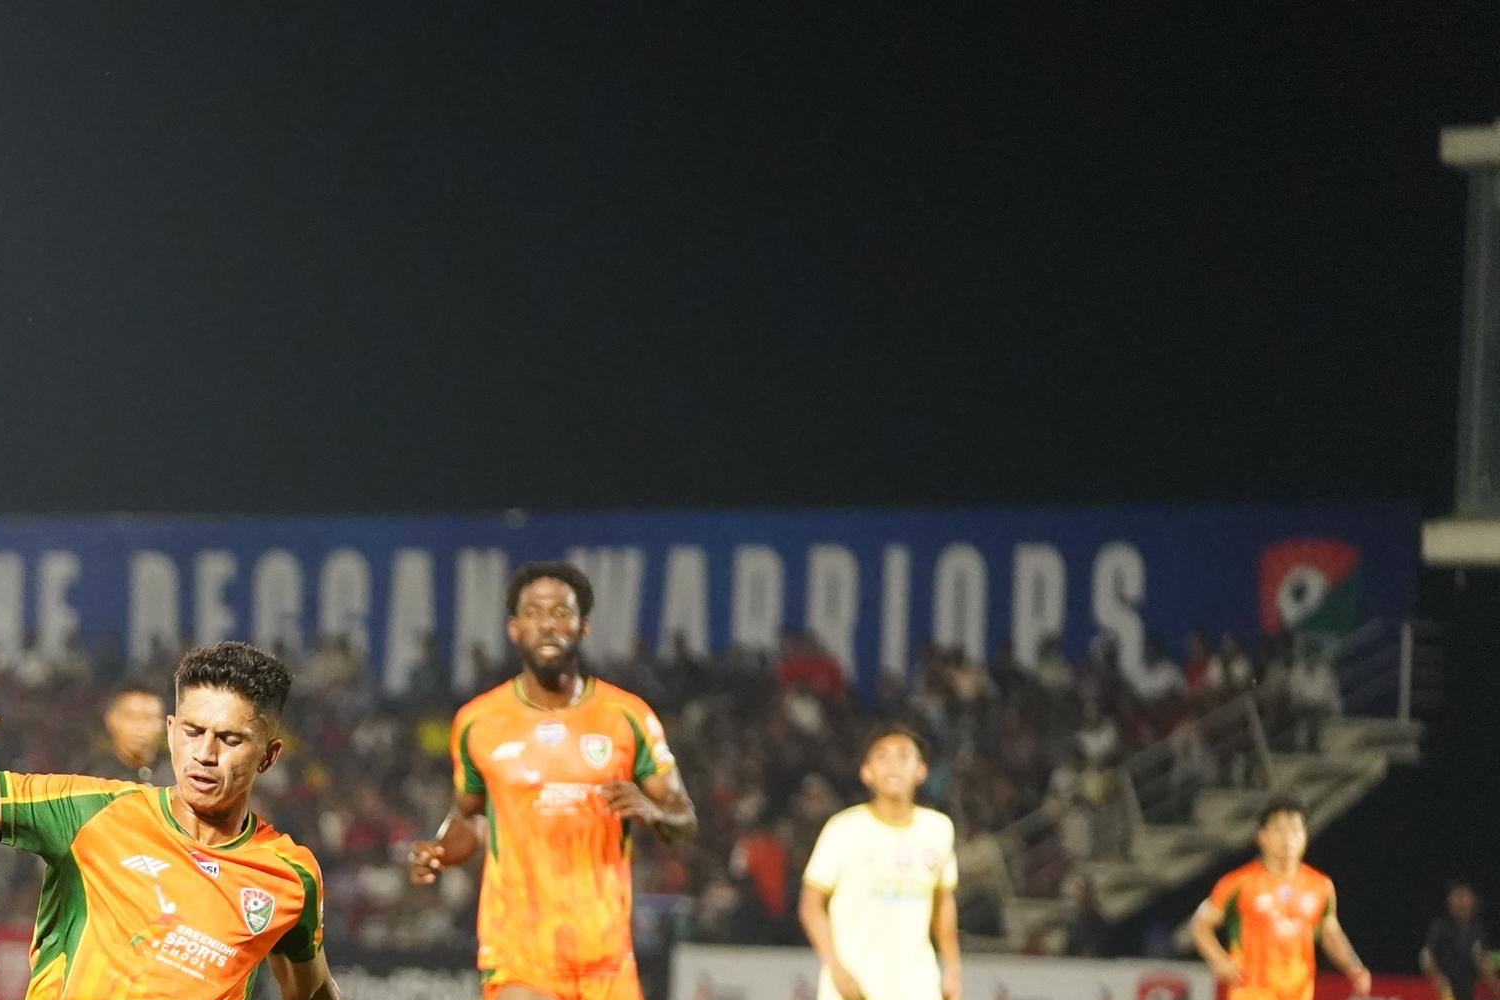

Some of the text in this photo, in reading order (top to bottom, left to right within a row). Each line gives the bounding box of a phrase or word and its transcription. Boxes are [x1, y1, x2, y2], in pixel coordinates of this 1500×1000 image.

[566, 542, 1183, 698] WARRIORS
[151, 939, 207, 969] SCHOOL
[164, 931, 228, 968] SPORTS
[176, 924, 238, 958] SREENIDHI
